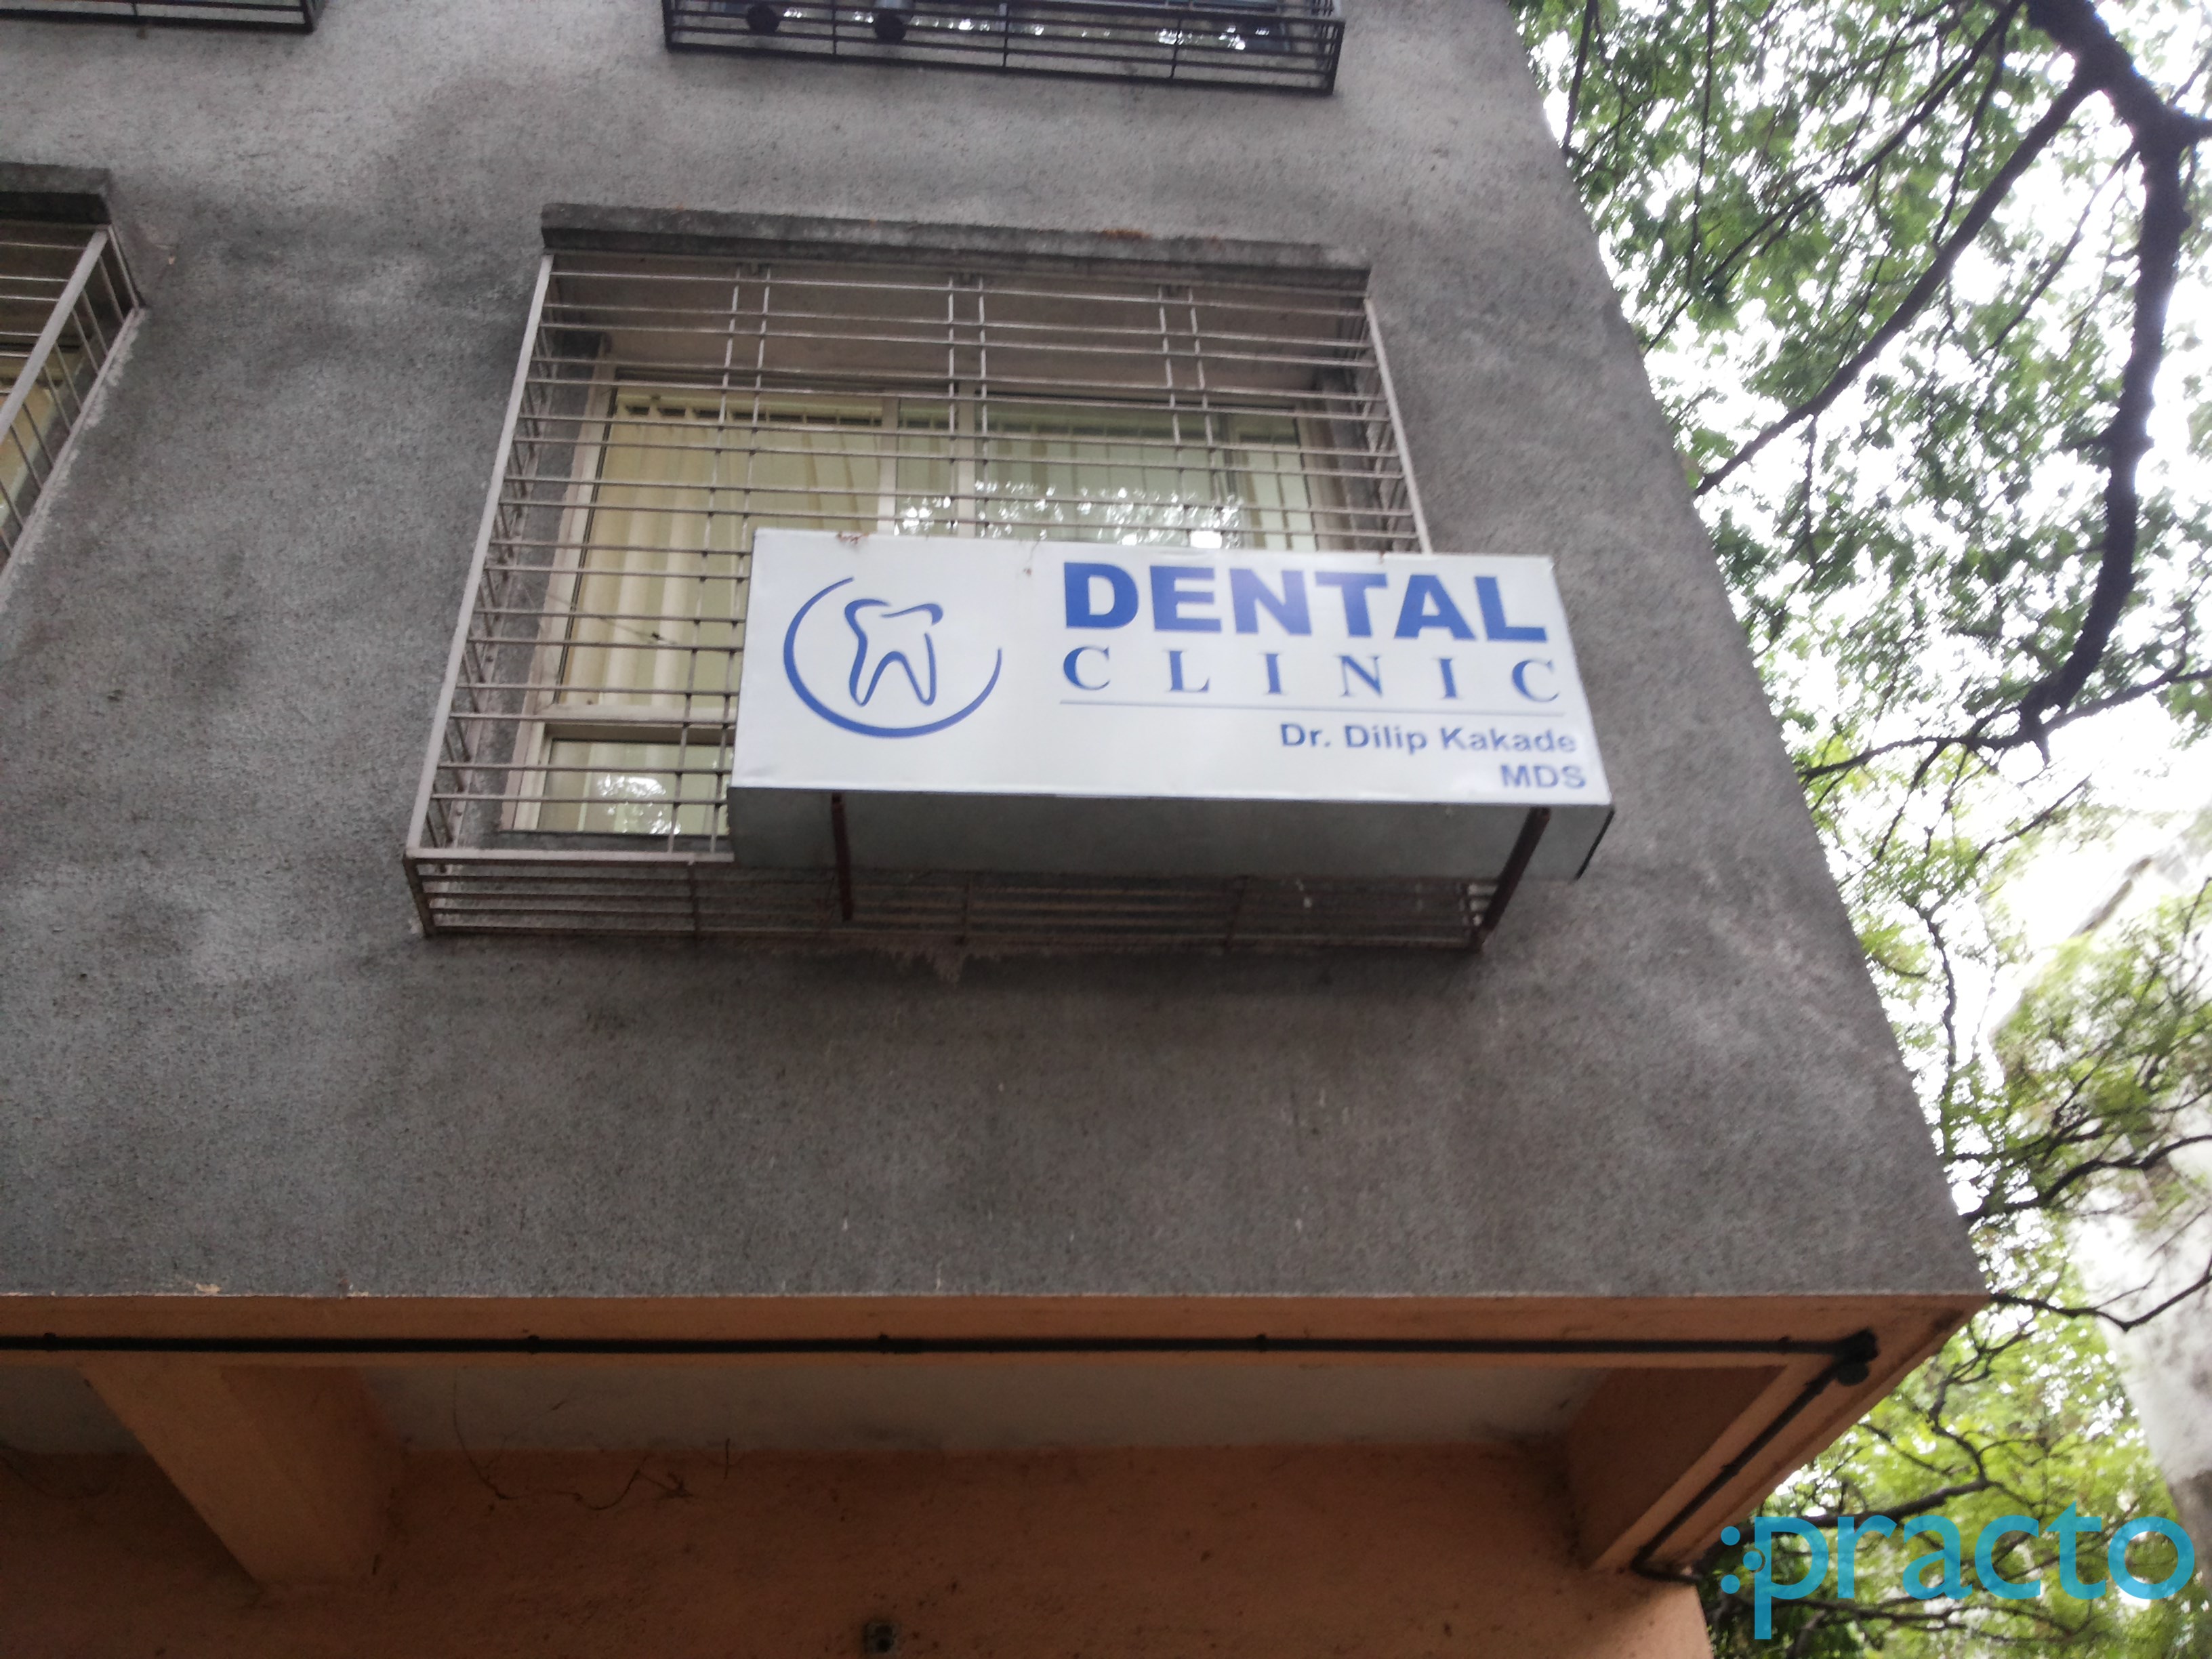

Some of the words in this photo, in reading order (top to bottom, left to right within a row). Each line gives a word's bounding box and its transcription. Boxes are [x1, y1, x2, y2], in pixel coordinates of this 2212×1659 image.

[1063, 561, 1548, 642] DENTAL
[1062, 645, 1560, 703] CLINIC
[1280, 722, 1331, 749] Dr.
[1345, 724, 1427, 755] Dilip
[1441, 726, 1577, 754] Kakade
[1500, 764, 1587, 790] MDS
